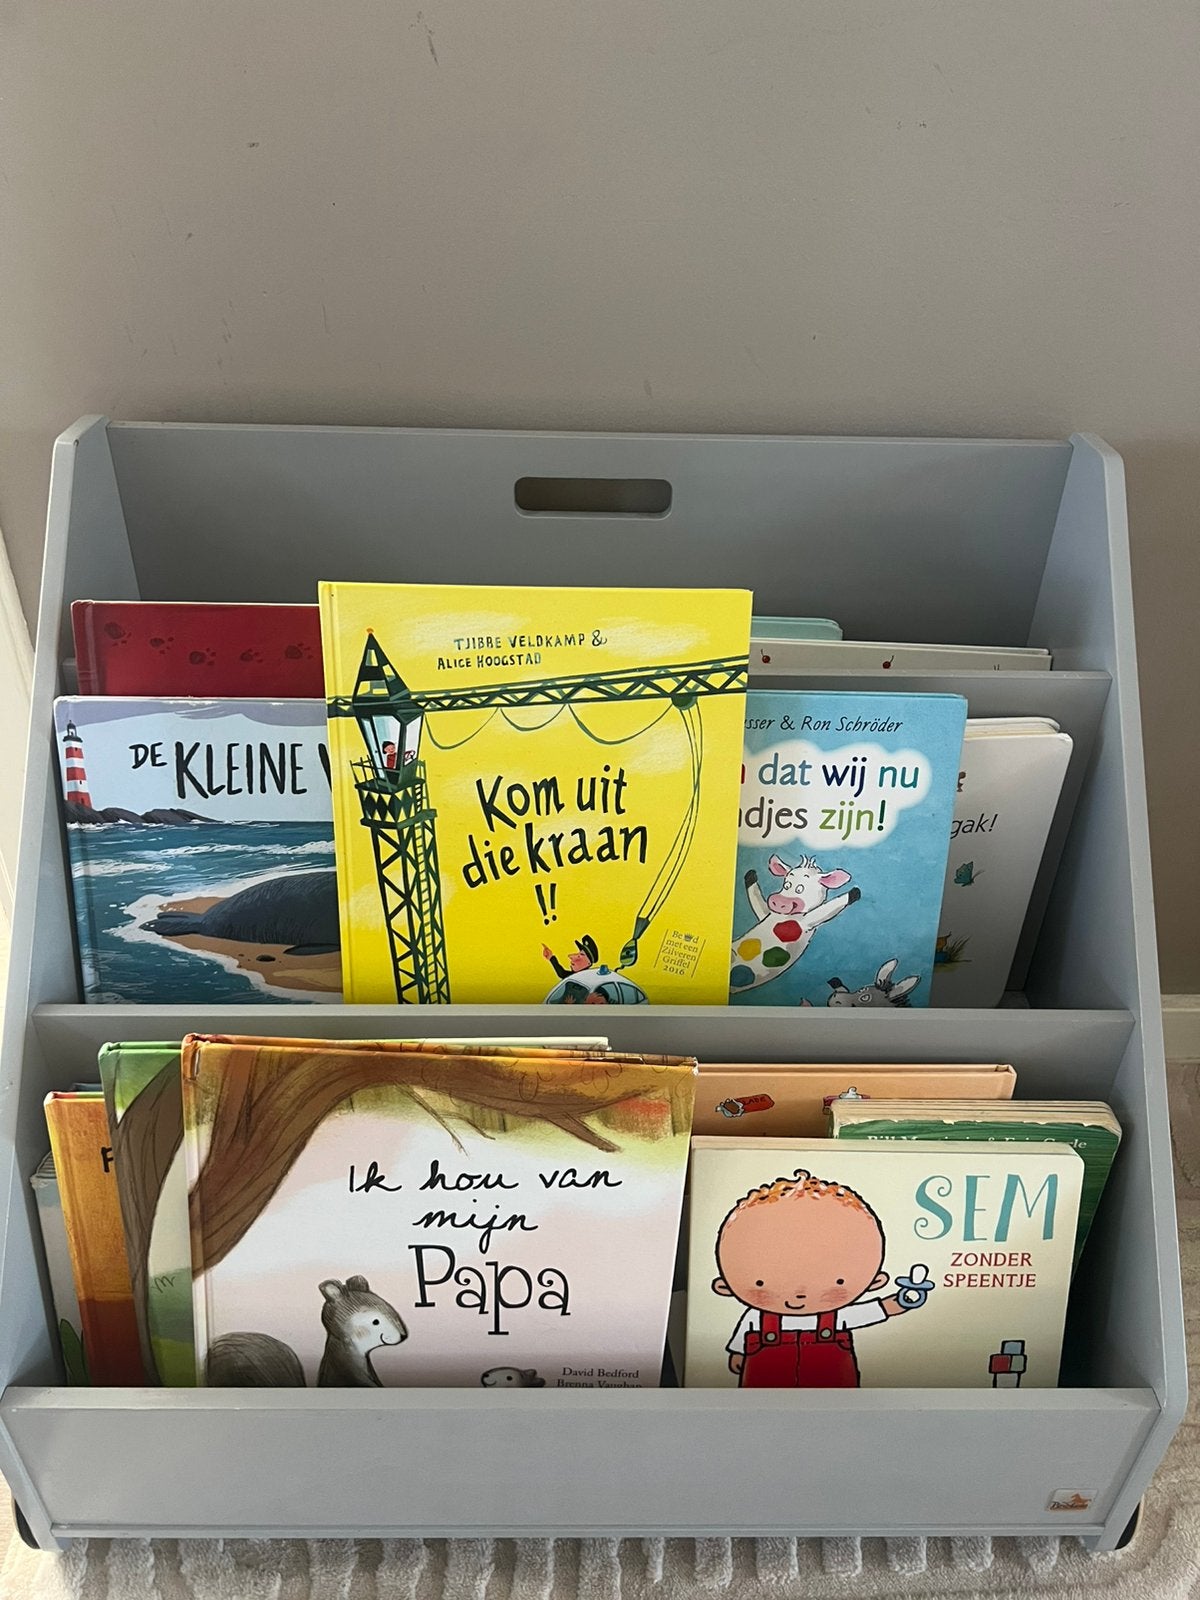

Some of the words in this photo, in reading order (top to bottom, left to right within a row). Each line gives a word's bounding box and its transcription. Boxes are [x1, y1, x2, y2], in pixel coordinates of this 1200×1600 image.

[508, 633, 585, 648] VELDKAMP
[591, 629, 608, 647] &
[437, 657, 472, 670] ALICE
[477, 652, 541, 668] HOOGSTAD
[780, 715, 796, 731] &
[801, 715, 831, 731] Ron
[835, 716, 903, 732] Schröder
[129, 742, 168, 769] DE
[175, 741, 307, 799] KLEINE
[758, 752, 812, 786] dat
[822, 756, 867, 798] wij
[878, 766, 918, 788] nu
[475, 775, 565, 832] Kom
[577, 764, 628, 815] uit
[819, 800, 886, 840] zijn!
[462, 834, 520, 888] die
[524, 823, 649, 874] kraan
[662, 946, 697, 961] Zilveren
[662, 956, 690, 969] Griffel
[663, 965, 685, 975] 2016
[349, 1161, 402, 1193] Ik
[419, 1159, 519, 1191] hou
[538, 1168, 623, 1189] van
[913, 1173, 1059, 1243] SEM
[412, 1198, 539, 1254] mijn
[950, 1252, 1033, 1267] ZONDER
[408, 1244, 571, 1335] Papa
[943, 1273, 1037, 1288] SPEENTJE
[562, 1367, 594, 1377] David
[597, 1368, 640, 1379] Bedford
